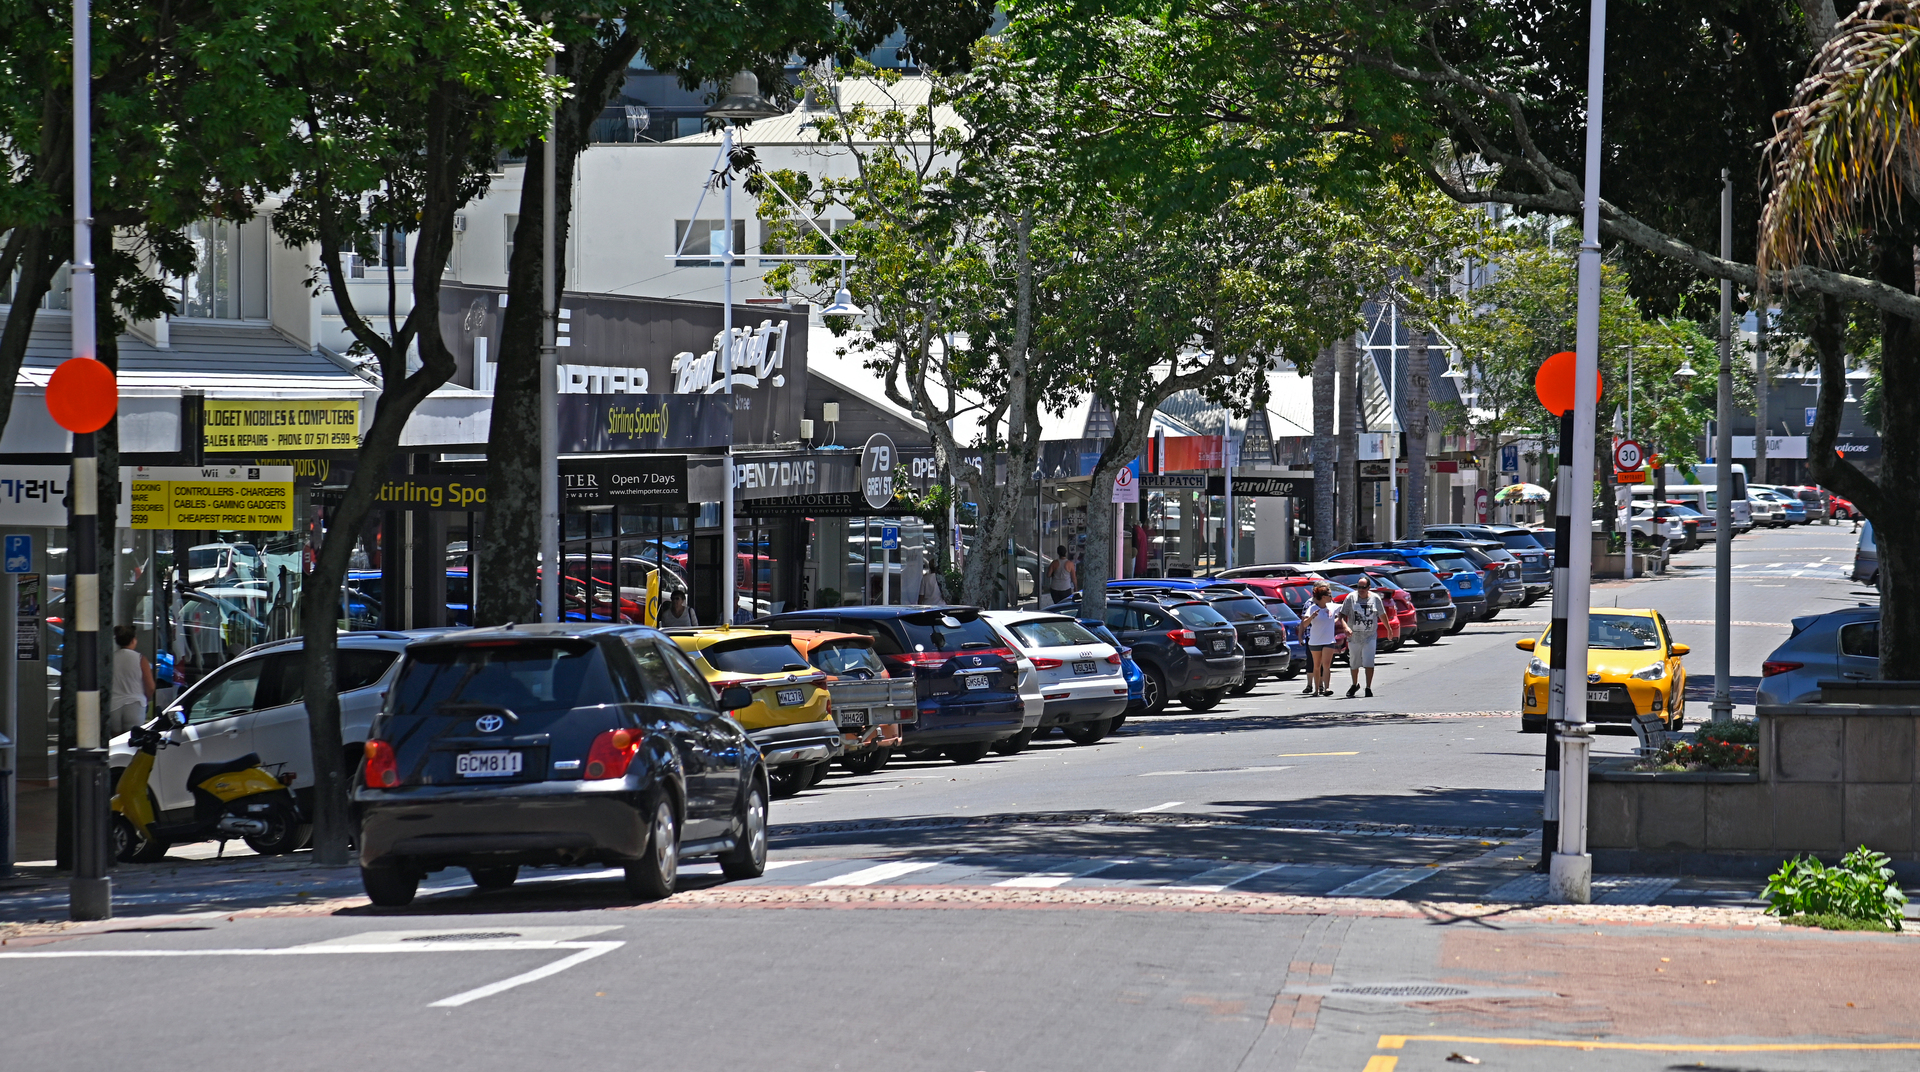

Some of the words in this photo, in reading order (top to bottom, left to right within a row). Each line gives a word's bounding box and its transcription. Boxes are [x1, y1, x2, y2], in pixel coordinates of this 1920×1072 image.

[244, 410, 286, 426] MOBILES
[299, 409, 354, 425] COMPUTERS
[608, 407, 634, 440] Stirling
[635, 406, 660, 438] Sports
[204, 434, 228, 446] SALES
[238, 434, 268, 446] REPAIRS
[278, 434, 302, 446] PHONE
[305, 433, 314, 444] 07
[317, 433, 328, 444] 571
[332, 433, 350, 444] 2599
[870, 446, 890, 472] 79
[1622, 451, 1636, 461] 30
[201, 469, 219, 477] Wii
[612, 474, 640, 486] Open
[643, 474, 649, 484] 7
[652, 473, 676, 484] Days
[769, 463, 778, 486] 7
[781, 461, 815, 486] DAYS
[868, 477, 883, 496] GREY
[1138, 477, 1167, 486] RPLE
[1169, 477, 1203, 486] PATCH
[1231, 479, 1293, 493] caroline
[174, 486, 234, 496] CONTROLLERS
[241, 488, 286, 497] CHARGERS
[375, 482, 443, 507] tirling
[609, 487, 679, 496] www.theimporter.co.nz
[173, 500, 206, 509] CABLES
[213, 501, 245, 510] GAMING
[247, 501, 286, 510] GADGETS
[780, 494, 851, 505] IMPORTER
[177, 514, 220, 523] CHEAPEST
[222, 515, 246, 523] PRICE
[248, 515, 256, 523] IN
[258, 515, 282, 523] TOWN
[13, 538, 22, 551] P
[459, 755, 517, 771] GCM811
